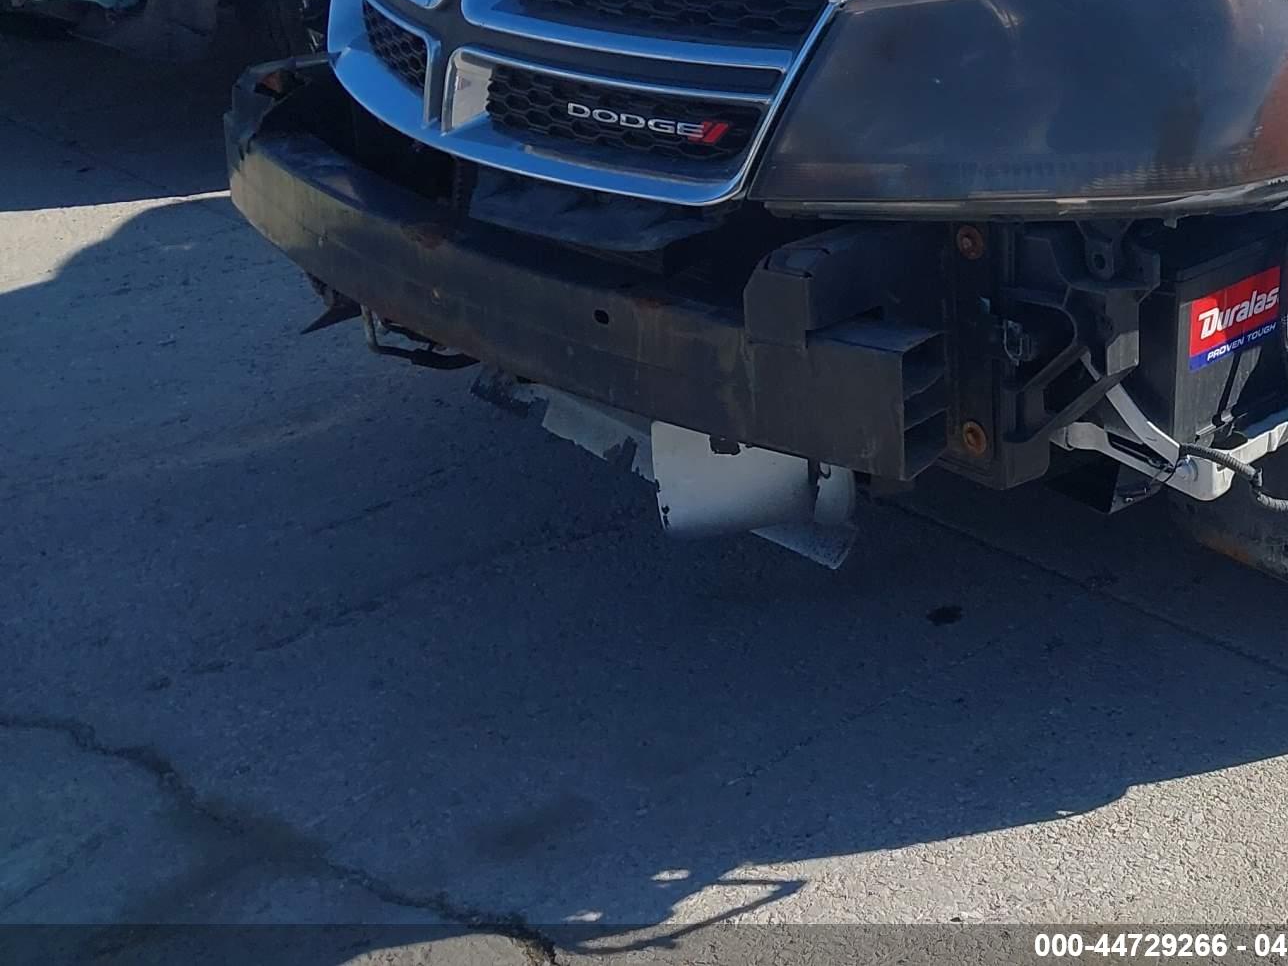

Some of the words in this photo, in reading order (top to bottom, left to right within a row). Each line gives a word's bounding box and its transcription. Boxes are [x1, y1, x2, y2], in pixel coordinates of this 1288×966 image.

[567, 102, 704, 138] DODGE
[1198, 287, 1280, 340] Duralas
[1207, 336, 1245, 361] PROVEN
[1247, 322, 1277, 342] TOUGH
